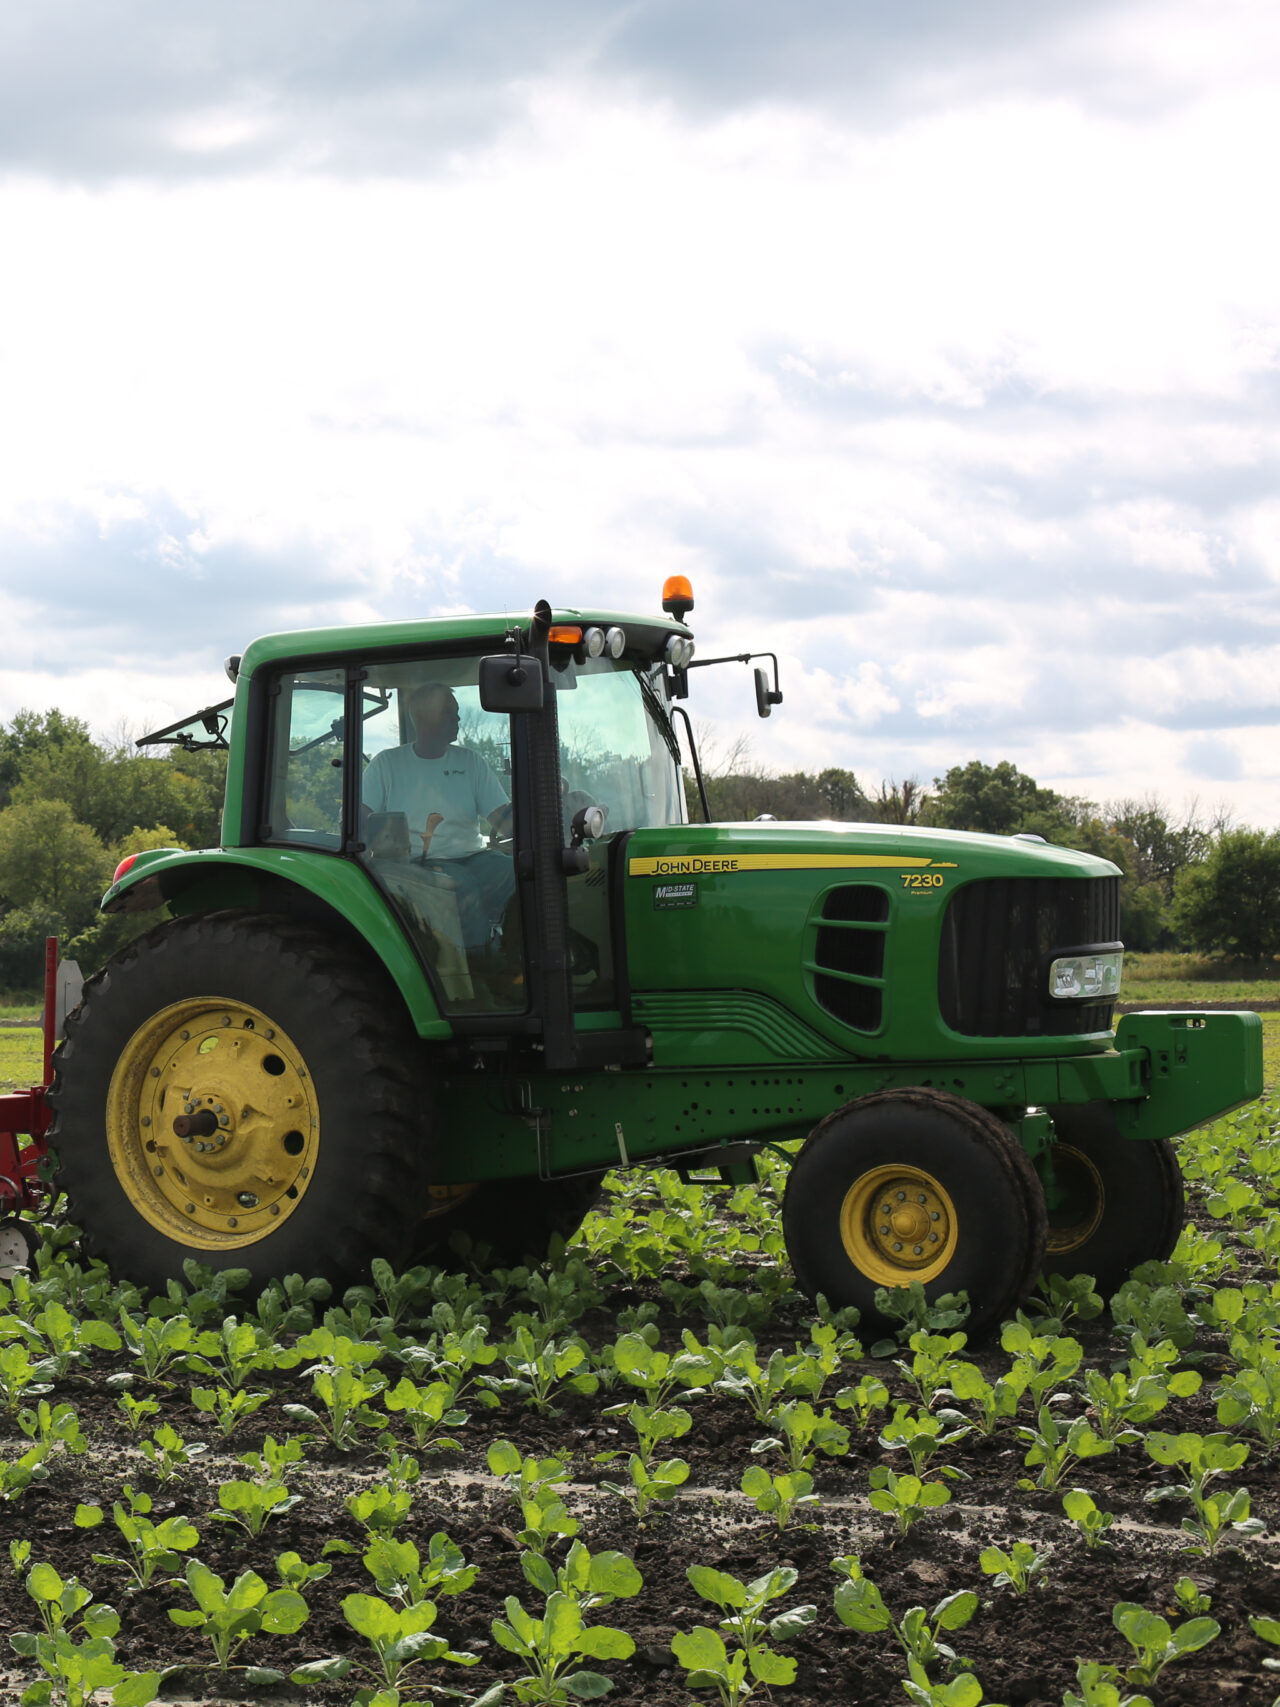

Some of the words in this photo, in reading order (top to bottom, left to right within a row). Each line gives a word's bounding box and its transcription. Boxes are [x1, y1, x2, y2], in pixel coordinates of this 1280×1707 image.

[651, 860, 690, 873] JOHN
[692, 859, 738, 871] DEERE
[900, 873, 944, 887] 7230
[655, 884, 695, 898] MID-STATE
